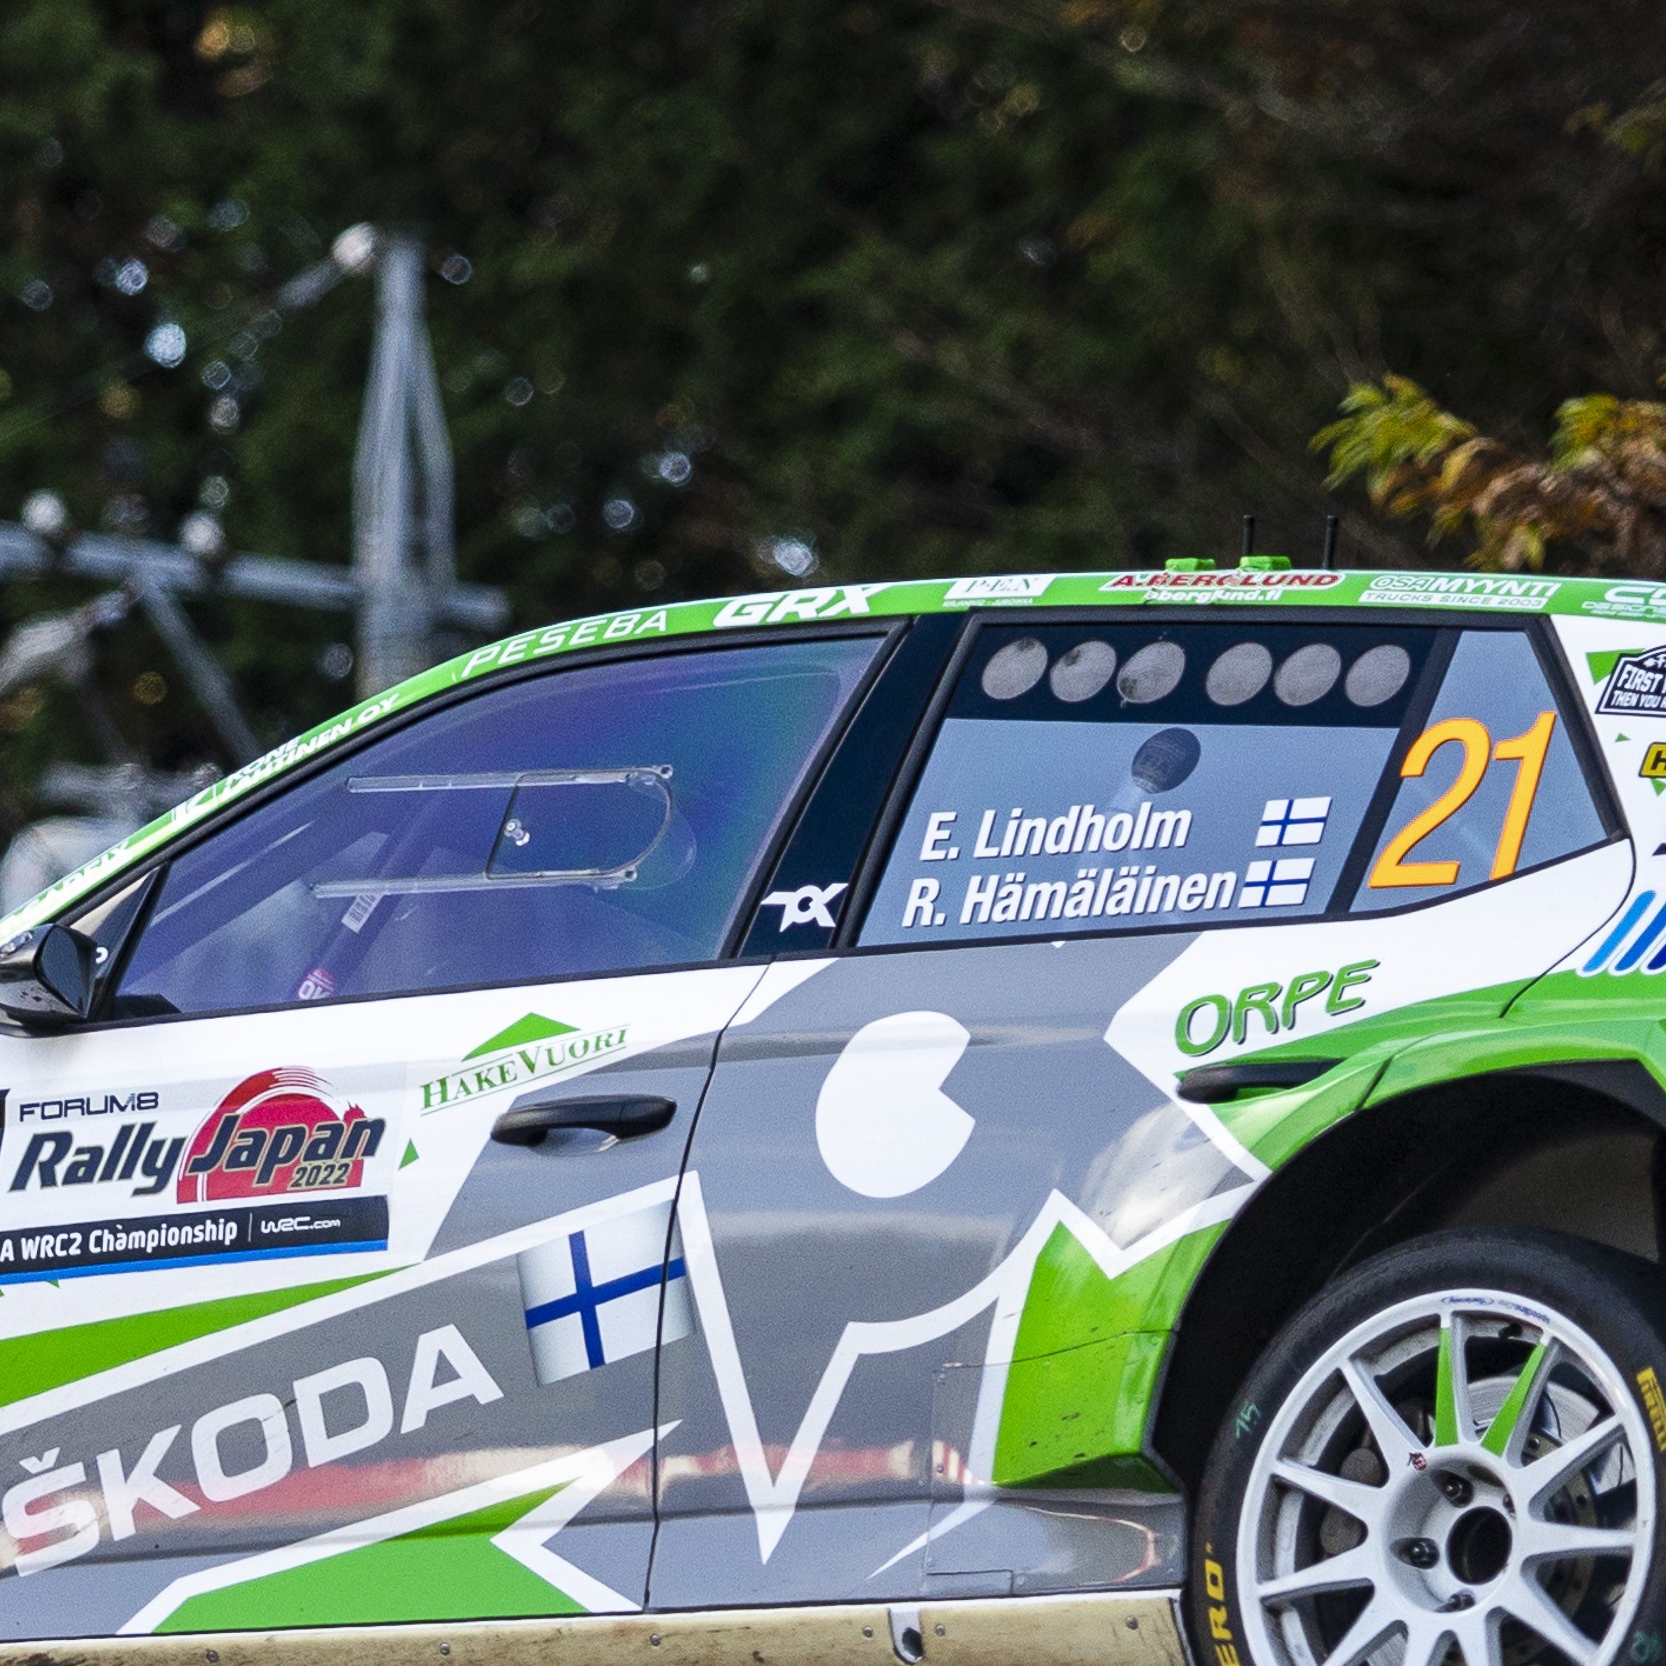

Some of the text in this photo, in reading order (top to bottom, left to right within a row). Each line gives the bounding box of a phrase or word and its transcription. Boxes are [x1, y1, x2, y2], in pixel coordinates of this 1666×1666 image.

[712, 584, 888, 629] GRX
[1365, 591, 1433, 603] TRUCKS
[1439, 595, 1493, 606] SINCE
[459, 610, 668, 678] PESEBA
[1610, 690, 1638, 707] THEN
[1638, 694, 1661, 709] YOU
[1616, 664, 1663, 694] FIRST
[356, 693, 400, 724] OY
[1367, 710, 1558, 890] 21
[919, 802, 1193, 862] E. Lindholm
[901, 867, 1237, 927] R. Hämäläinen
[1175, 958, 1381, 1057] ORPE
[19, 1091, 159, 1122] FORUM8
[8, 1114, 387, 1197] Rally Japan
[289, 1162, 350, 1190] 2022
[21, 1231, 81, 1260] WRC2
[89, 1219, 238, 1259] Championship
[1, 1323, 504, 1578] ŠKODA
